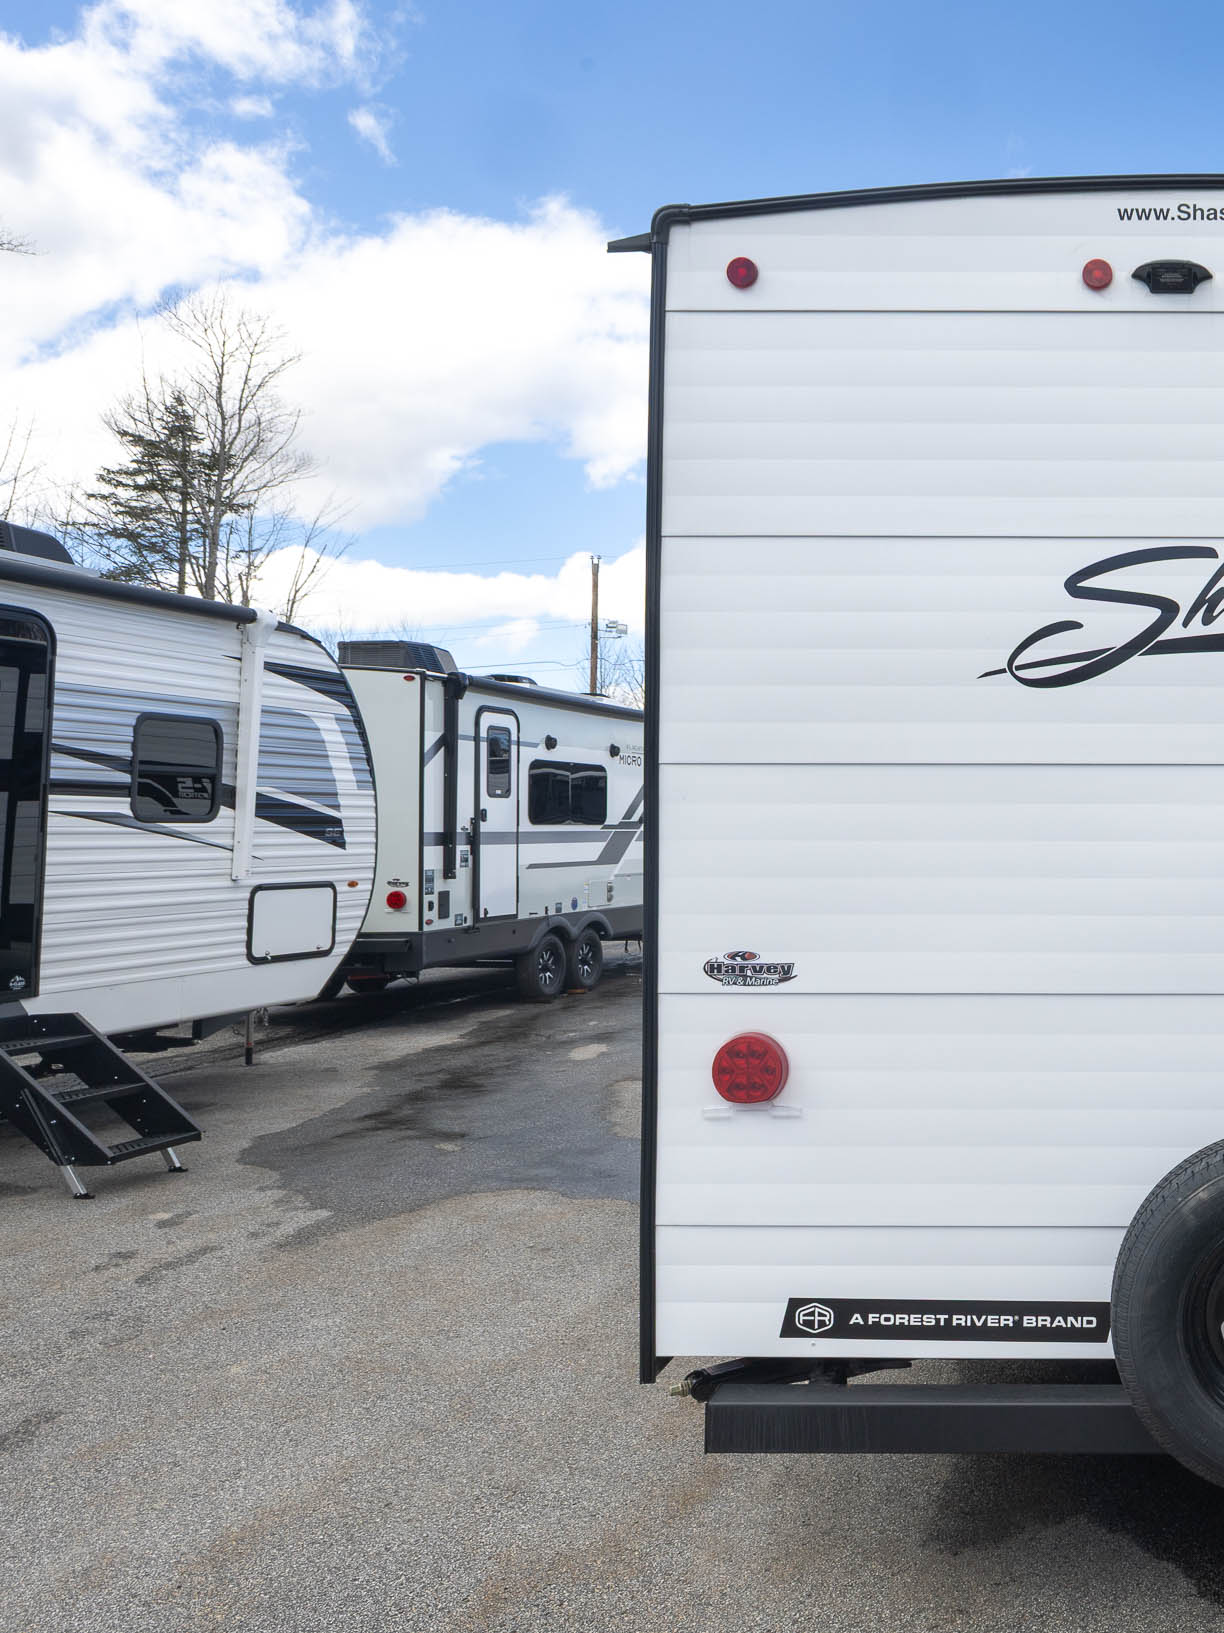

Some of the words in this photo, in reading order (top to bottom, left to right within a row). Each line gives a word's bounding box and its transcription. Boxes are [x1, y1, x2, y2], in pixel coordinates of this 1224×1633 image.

[619, 755, 642, 767] MICRO
[707, 962, 794, 977] Harvey
[722, 977, 735, 985] RV
[746, 977, 779, 986] Marine
[849, 1313, 864, 1325] A
[868, 1314, 949, 1326] FOREST
[1023, 1316, 1097, 1328] BRAND
